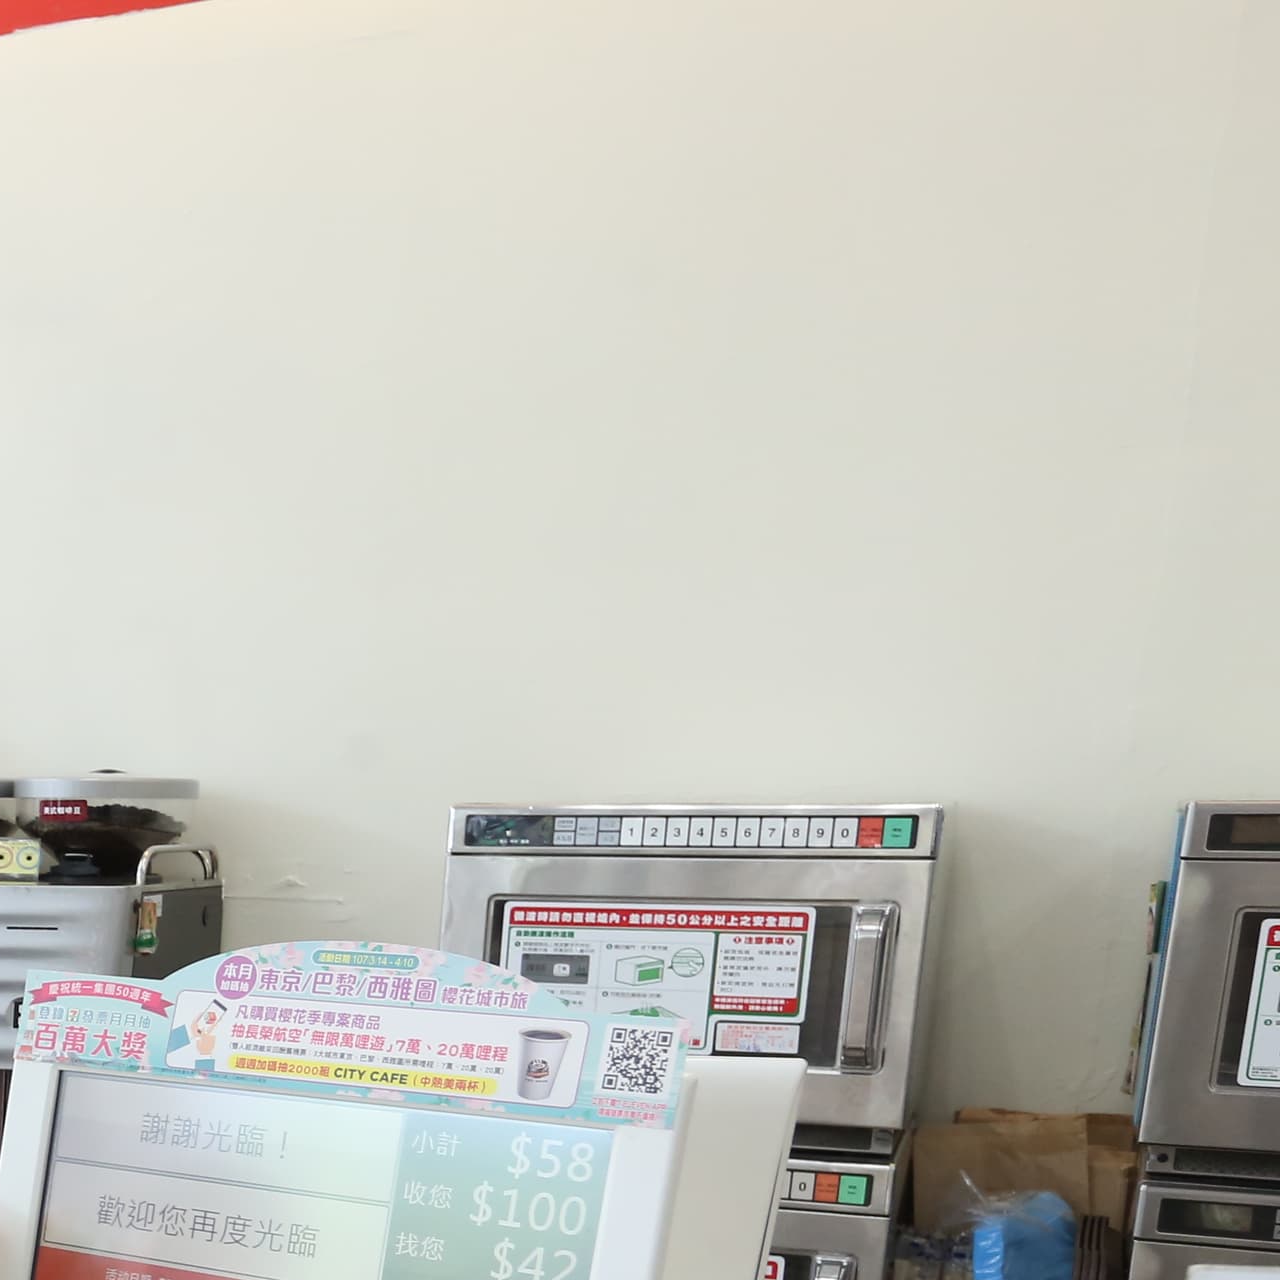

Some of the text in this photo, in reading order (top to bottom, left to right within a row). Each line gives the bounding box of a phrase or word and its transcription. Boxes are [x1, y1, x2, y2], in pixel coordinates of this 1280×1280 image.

[224, 963, 253, 980] 本月
[259, 968, 437, 1003] 東京/巴黎/西雅圖
[32, 1023, 147, 1059] 百萬大獎
[334, 1067, 366, 1081] CITY
[370, 1069, 408, 1085] CAFE
[412, 1130, 594, 1182] 小計 $58
[403, 1180, 586, 1235] 收您 $100
[98, 1194, 320, 1258] 歡迎您再度光臨
[395, 1231, 445, 1261] 找您
